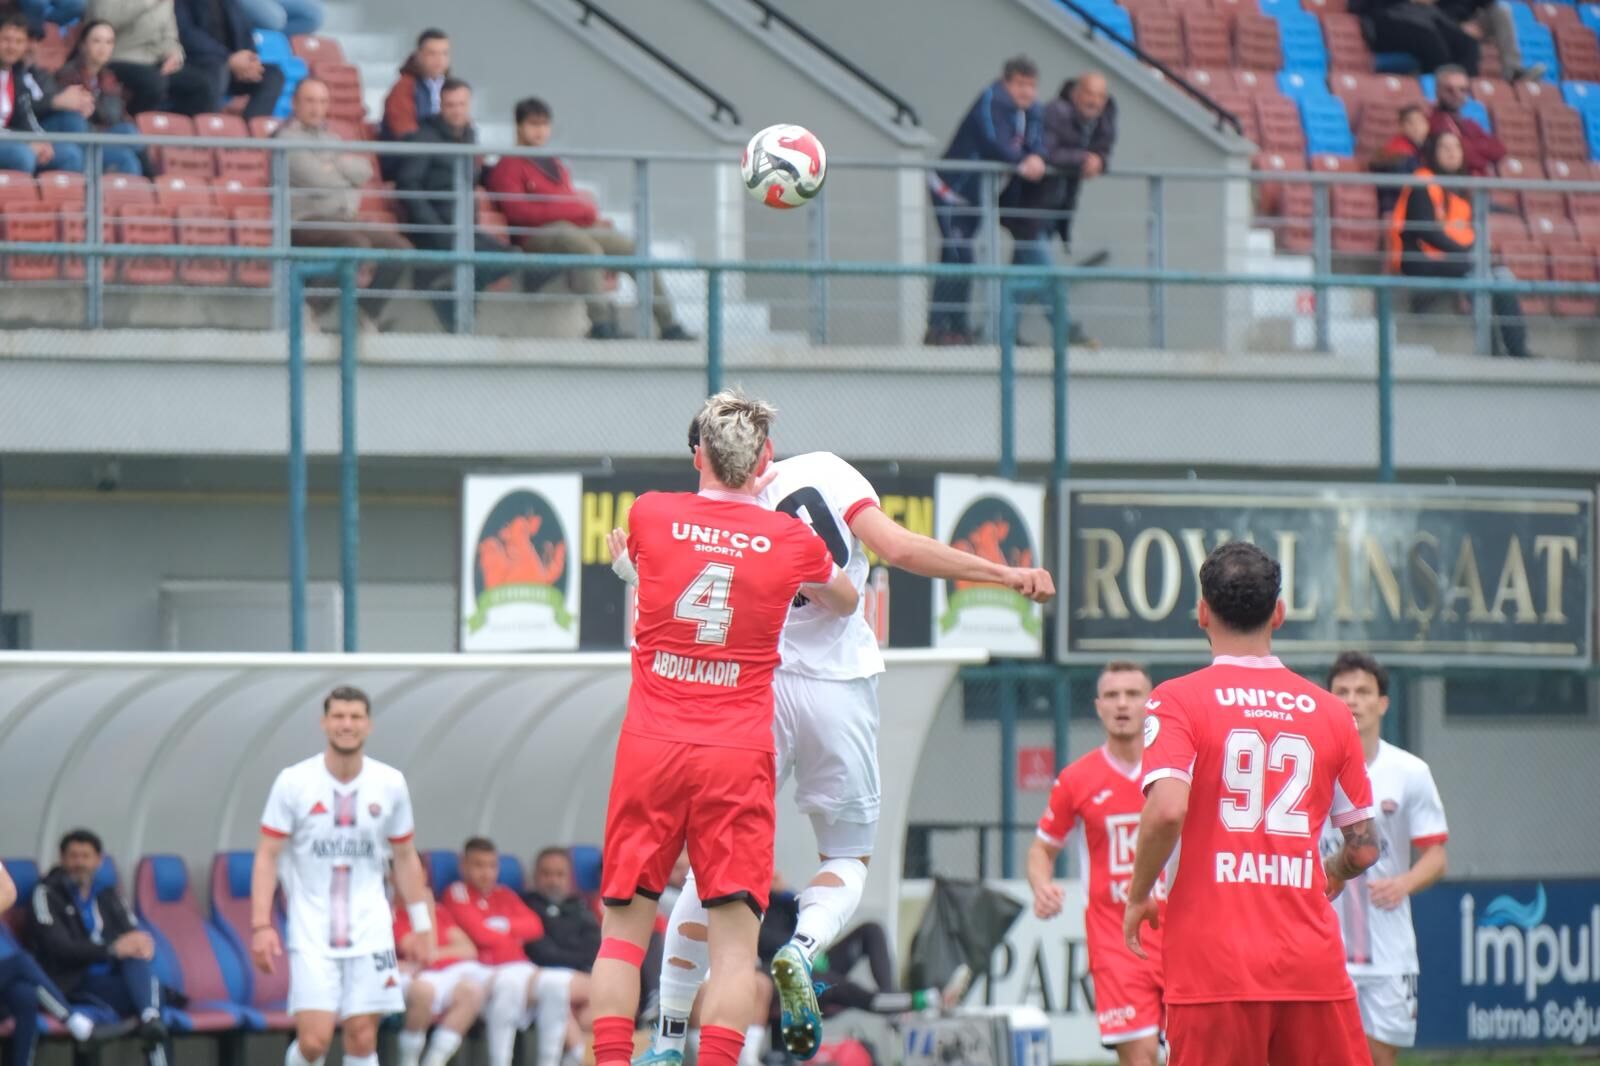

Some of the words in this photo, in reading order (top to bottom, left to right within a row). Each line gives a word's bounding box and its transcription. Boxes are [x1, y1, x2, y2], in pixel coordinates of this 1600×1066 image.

[673, 562, 735, 646] 4
[1219, 728, 1315, 838] 92
[1215, 849, 1313, 889] RAHMİ
